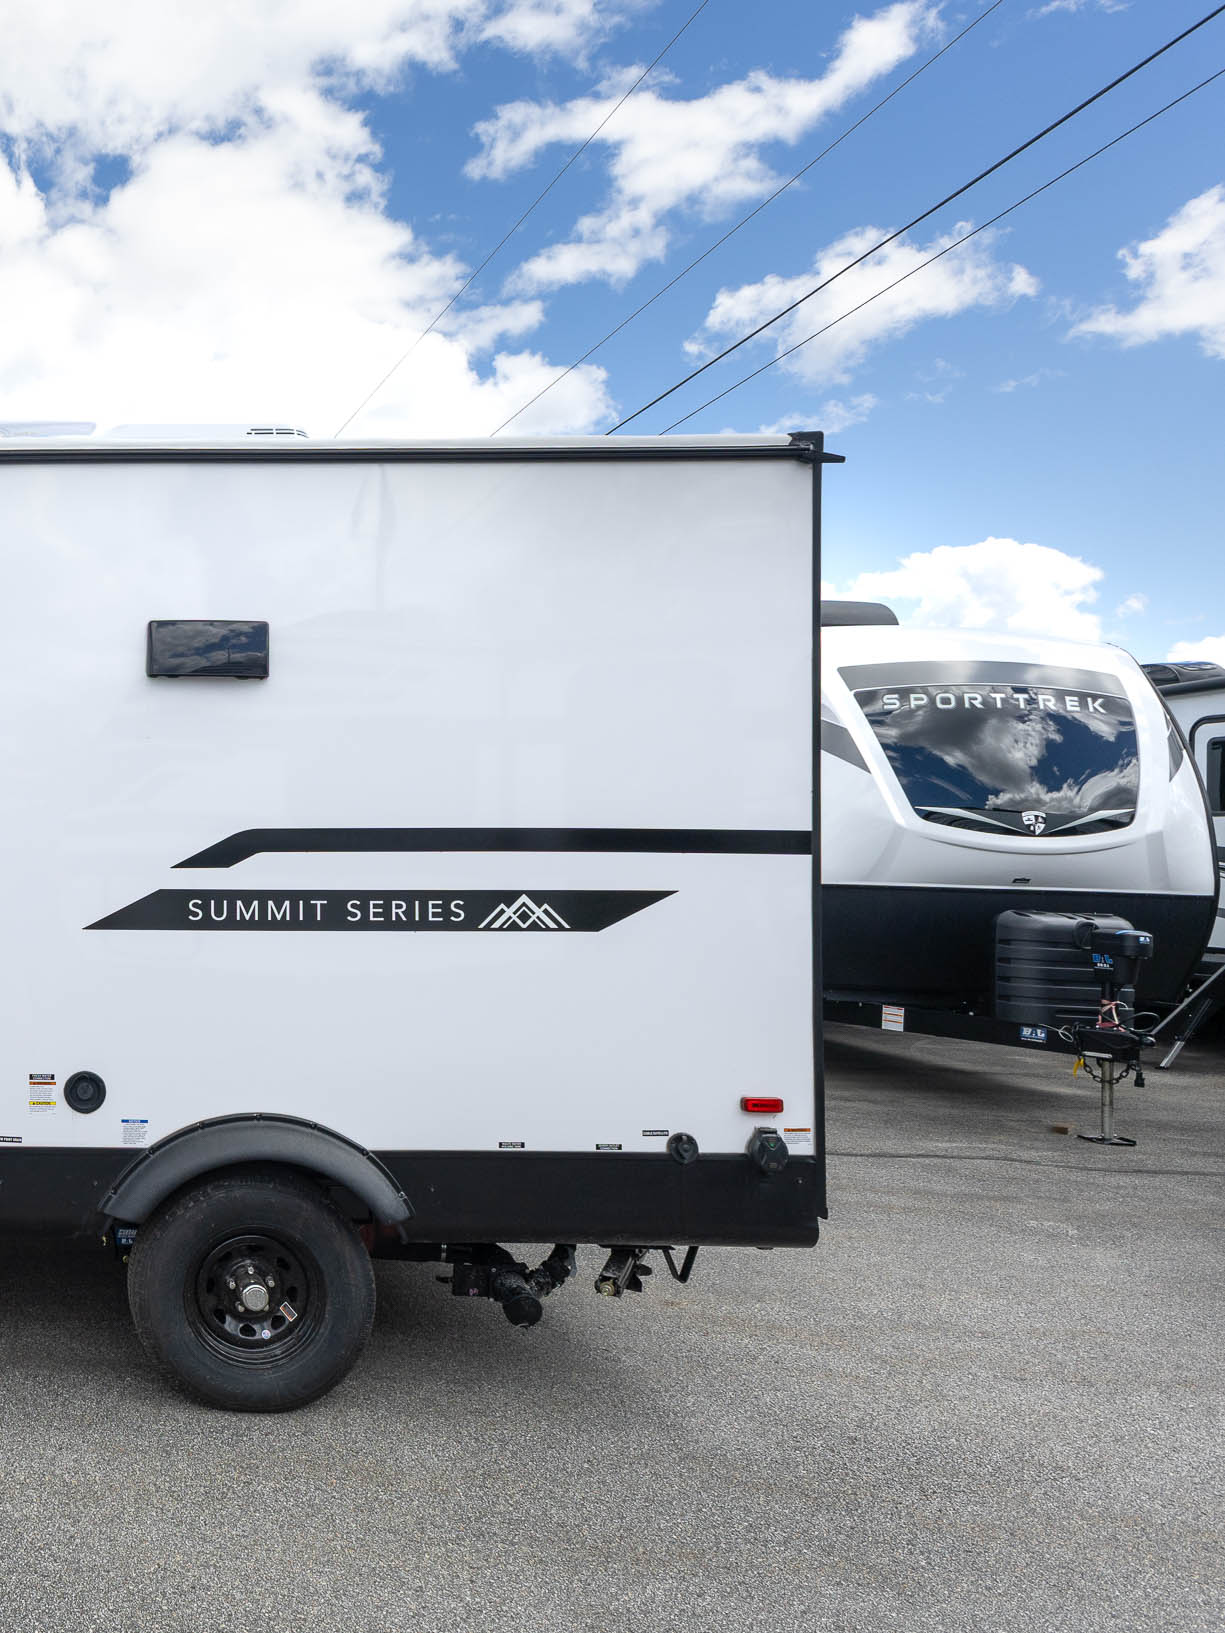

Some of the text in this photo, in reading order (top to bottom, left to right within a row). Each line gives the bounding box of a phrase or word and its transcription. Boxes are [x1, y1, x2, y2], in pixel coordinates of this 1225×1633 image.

[882, 692, 1107, 714] SPORTTREK
[187, 899, 465, 922] SUMMIT SERIES
